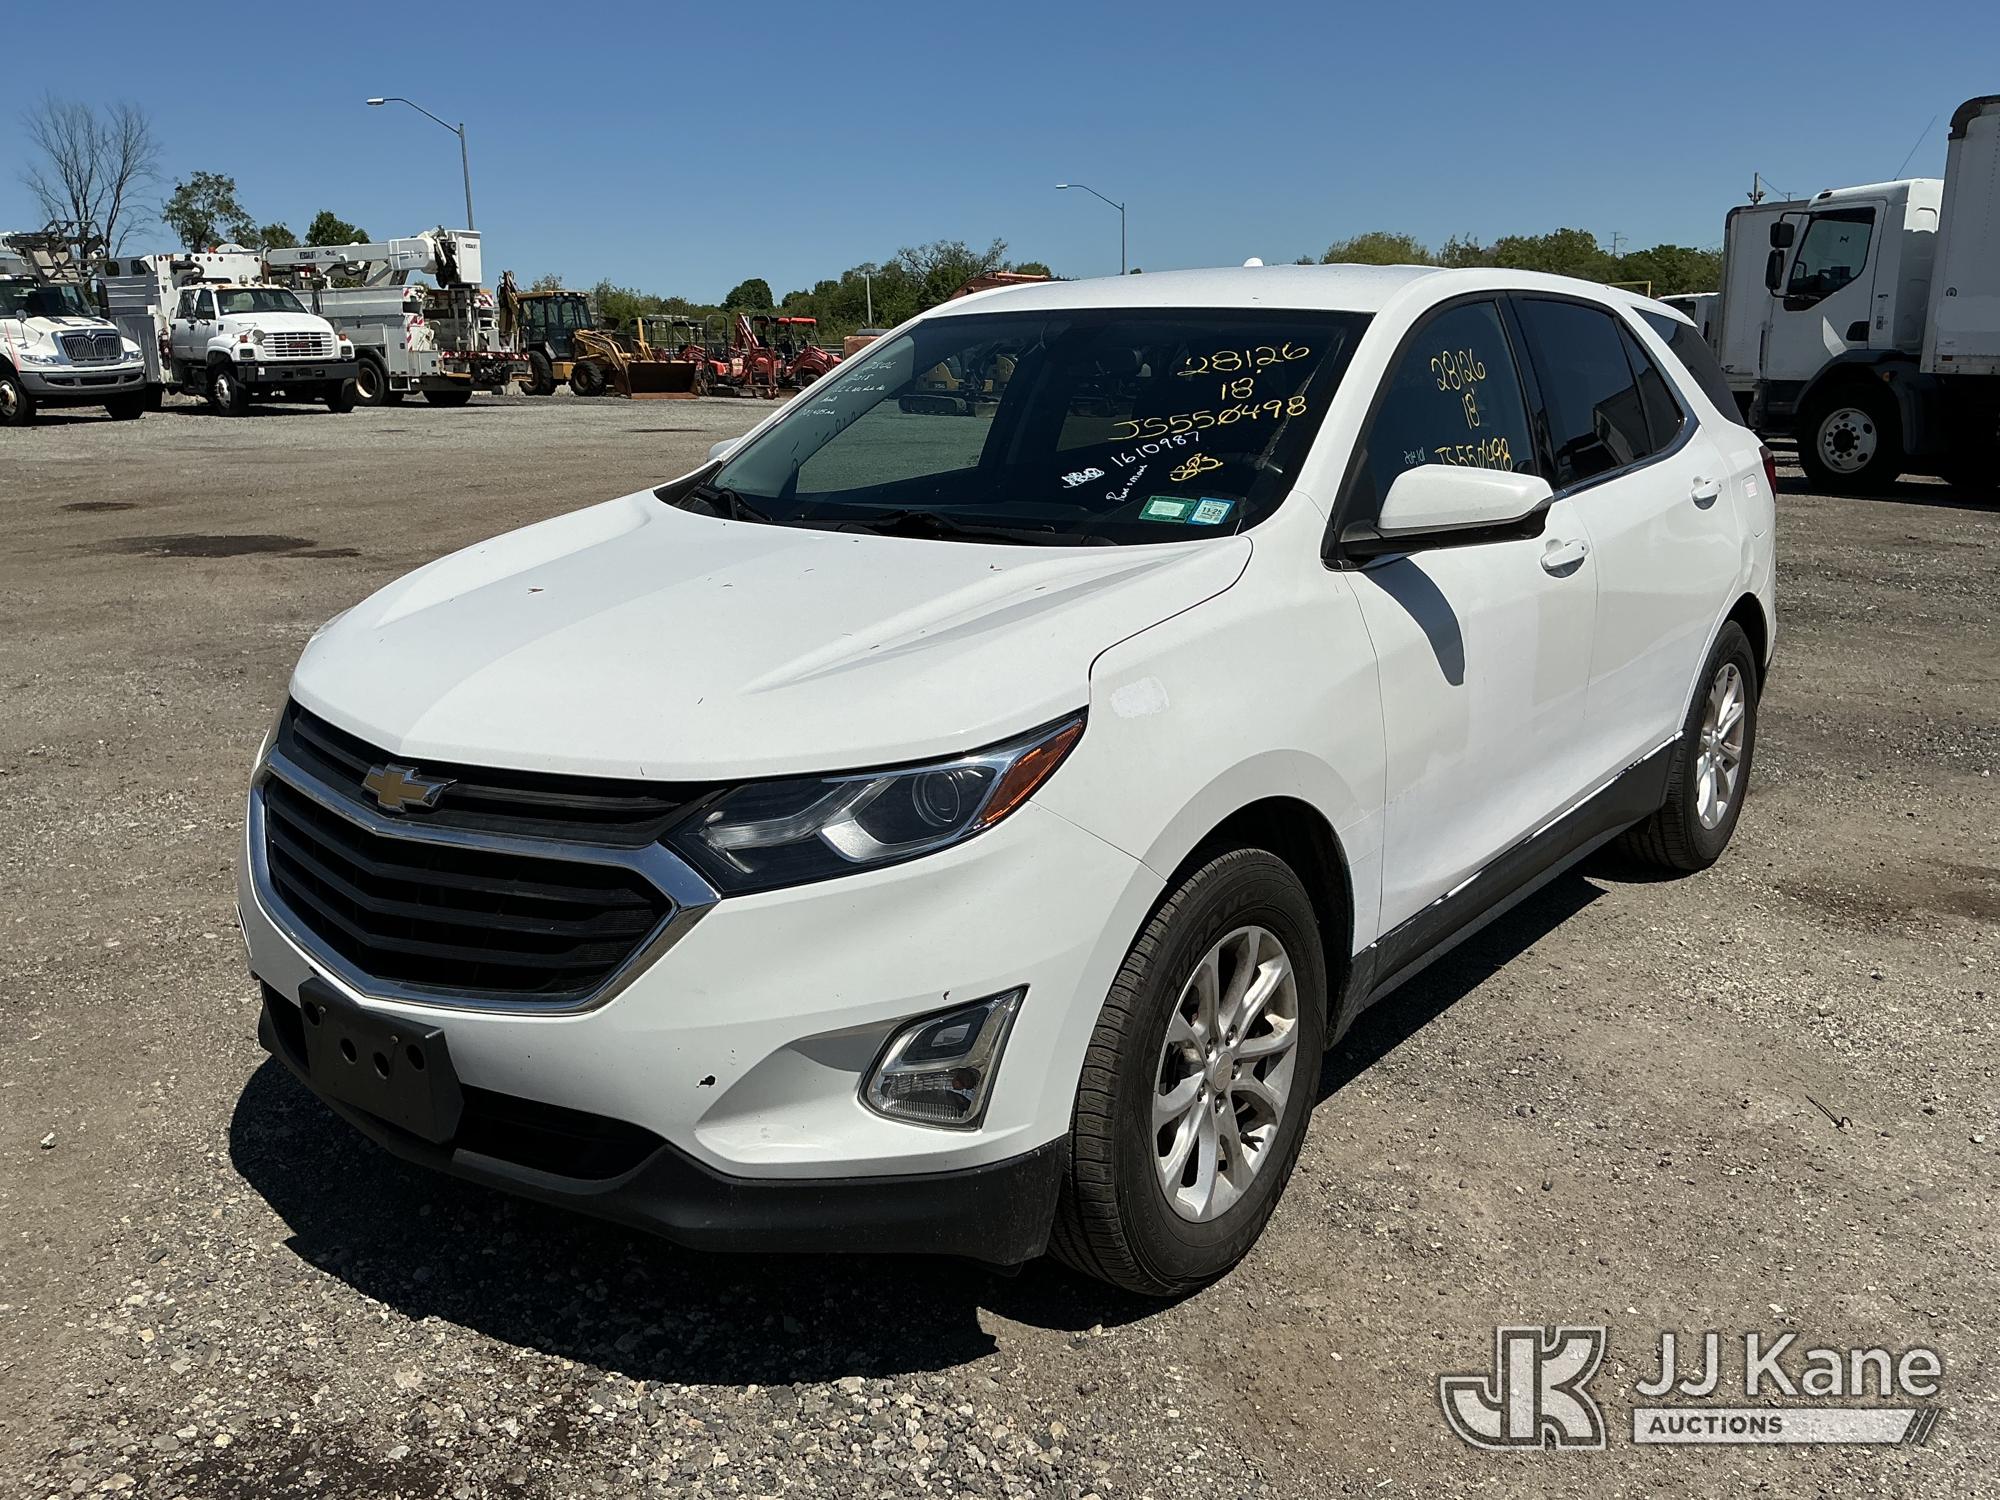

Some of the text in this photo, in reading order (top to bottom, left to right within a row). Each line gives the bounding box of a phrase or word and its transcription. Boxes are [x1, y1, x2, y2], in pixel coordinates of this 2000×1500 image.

[1177, 342, 1310, 376] 28126
[1431, 348, 1486, 391] 28126
[1221, 378, 1254, 400] 18
[1107, 395, 1307, 441] JS550498
[1462, 391, 1480, 430] 18
[1112, 431, 1200, 467] 1610987
